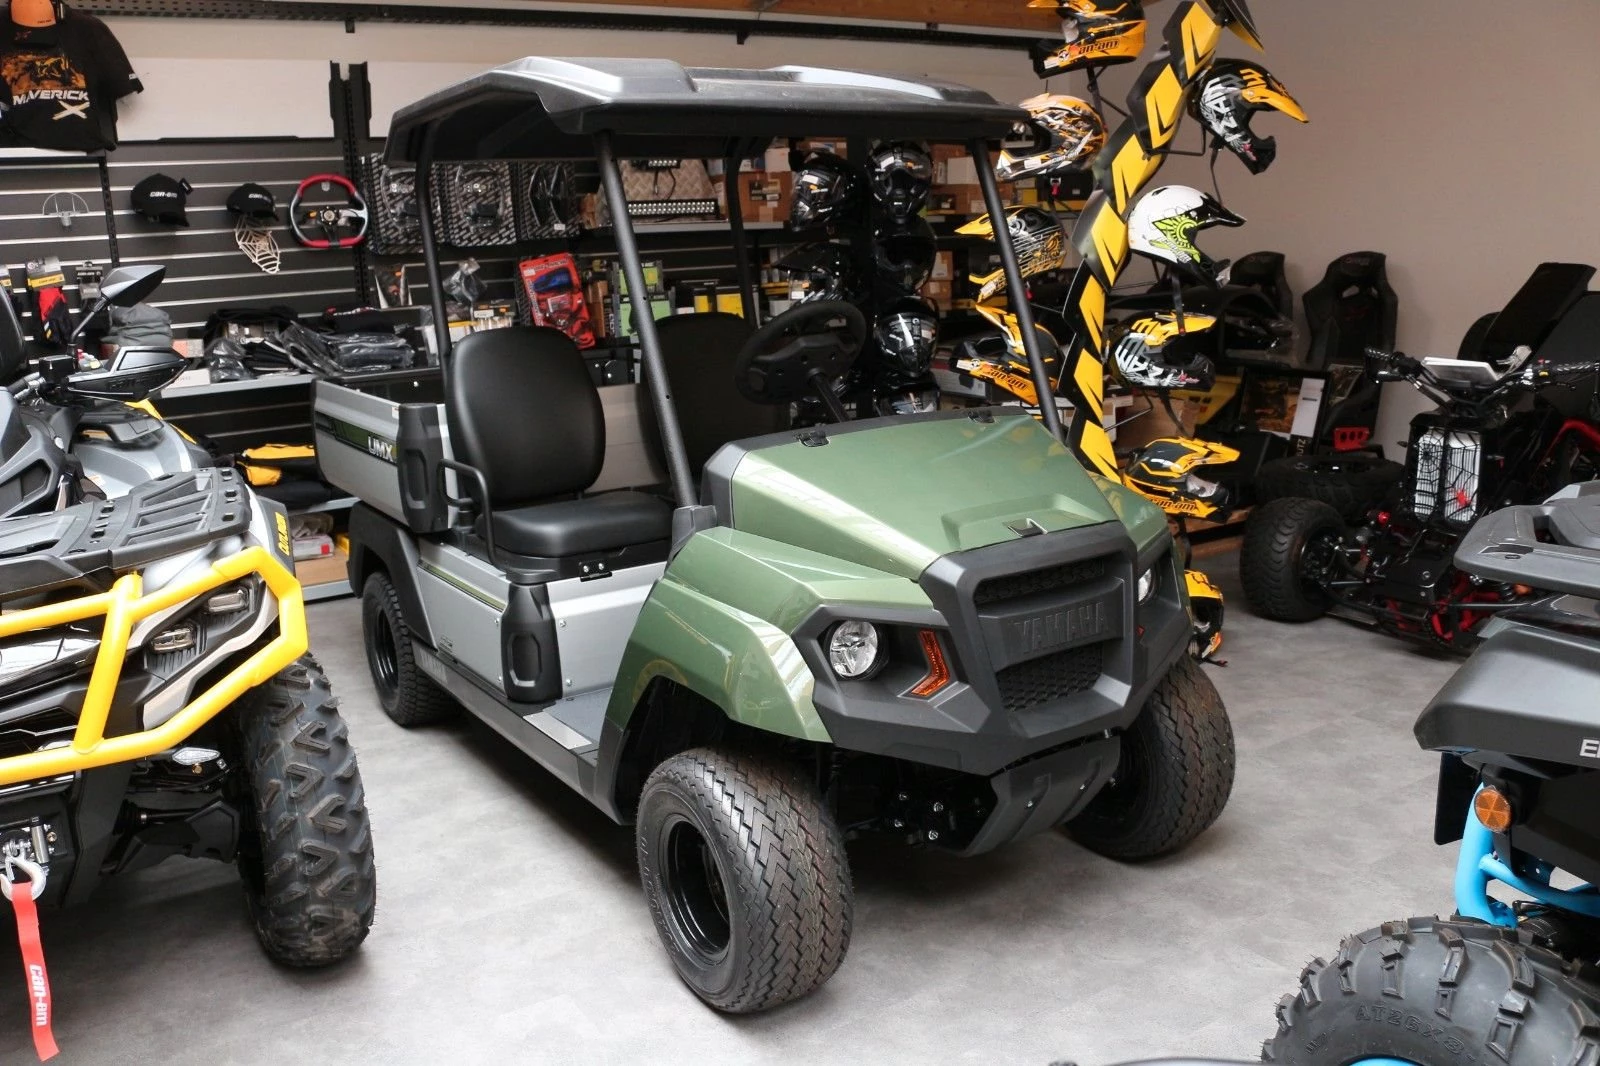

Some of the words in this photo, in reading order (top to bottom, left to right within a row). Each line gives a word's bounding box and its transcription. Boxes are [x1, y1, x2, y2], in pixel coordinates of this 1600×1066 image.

[1069, 41, 1119, 55] an-am
[12, 90, 90, 105] MAVERICK
[52, 100, 90, 120] X
[368, 436, 394, 462] UMX
[1151, 498, 1196, 511] an-am
[1012, 601, 1108, 654] YAMAHA
[29, 964, 48, 1027] can-am
